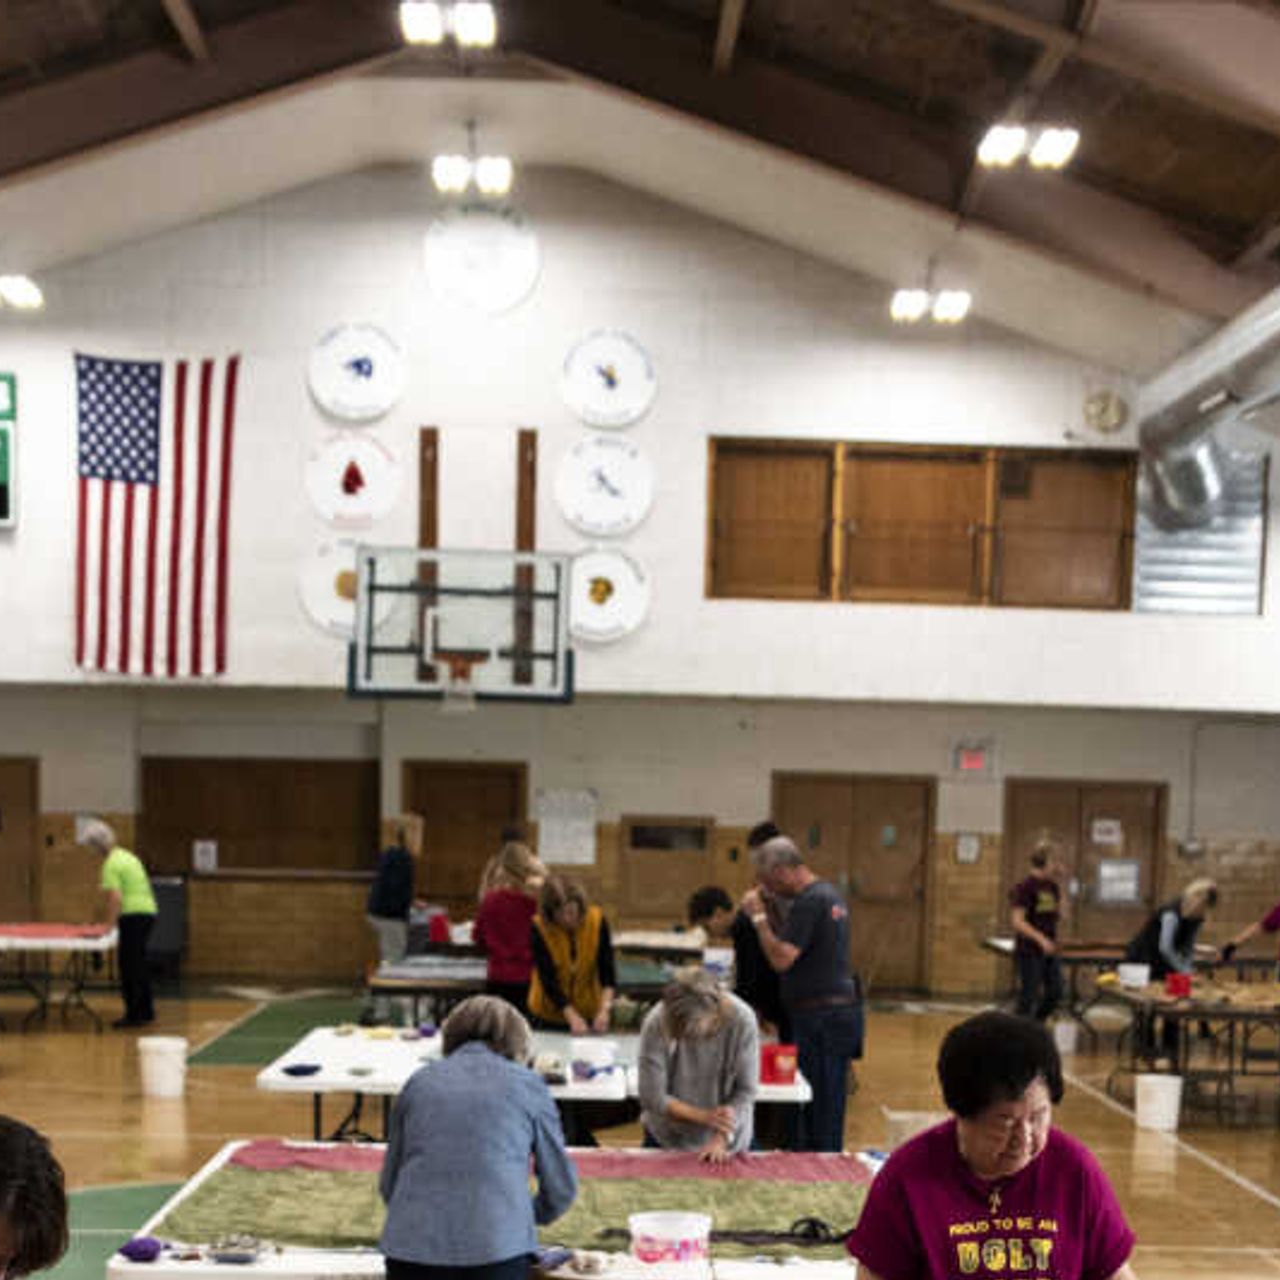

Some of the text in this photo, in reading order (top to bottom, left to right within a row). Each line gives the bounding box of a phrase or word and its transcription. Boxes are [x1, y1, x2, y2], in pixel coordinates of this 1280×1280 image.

[949, 1220, 990, 1237] PROUD
[991, 1217, 1013, 1231] TO
[1016, 1216, 1034, 1231] BE
[956, 1238, 1054, 1273] UGLY
